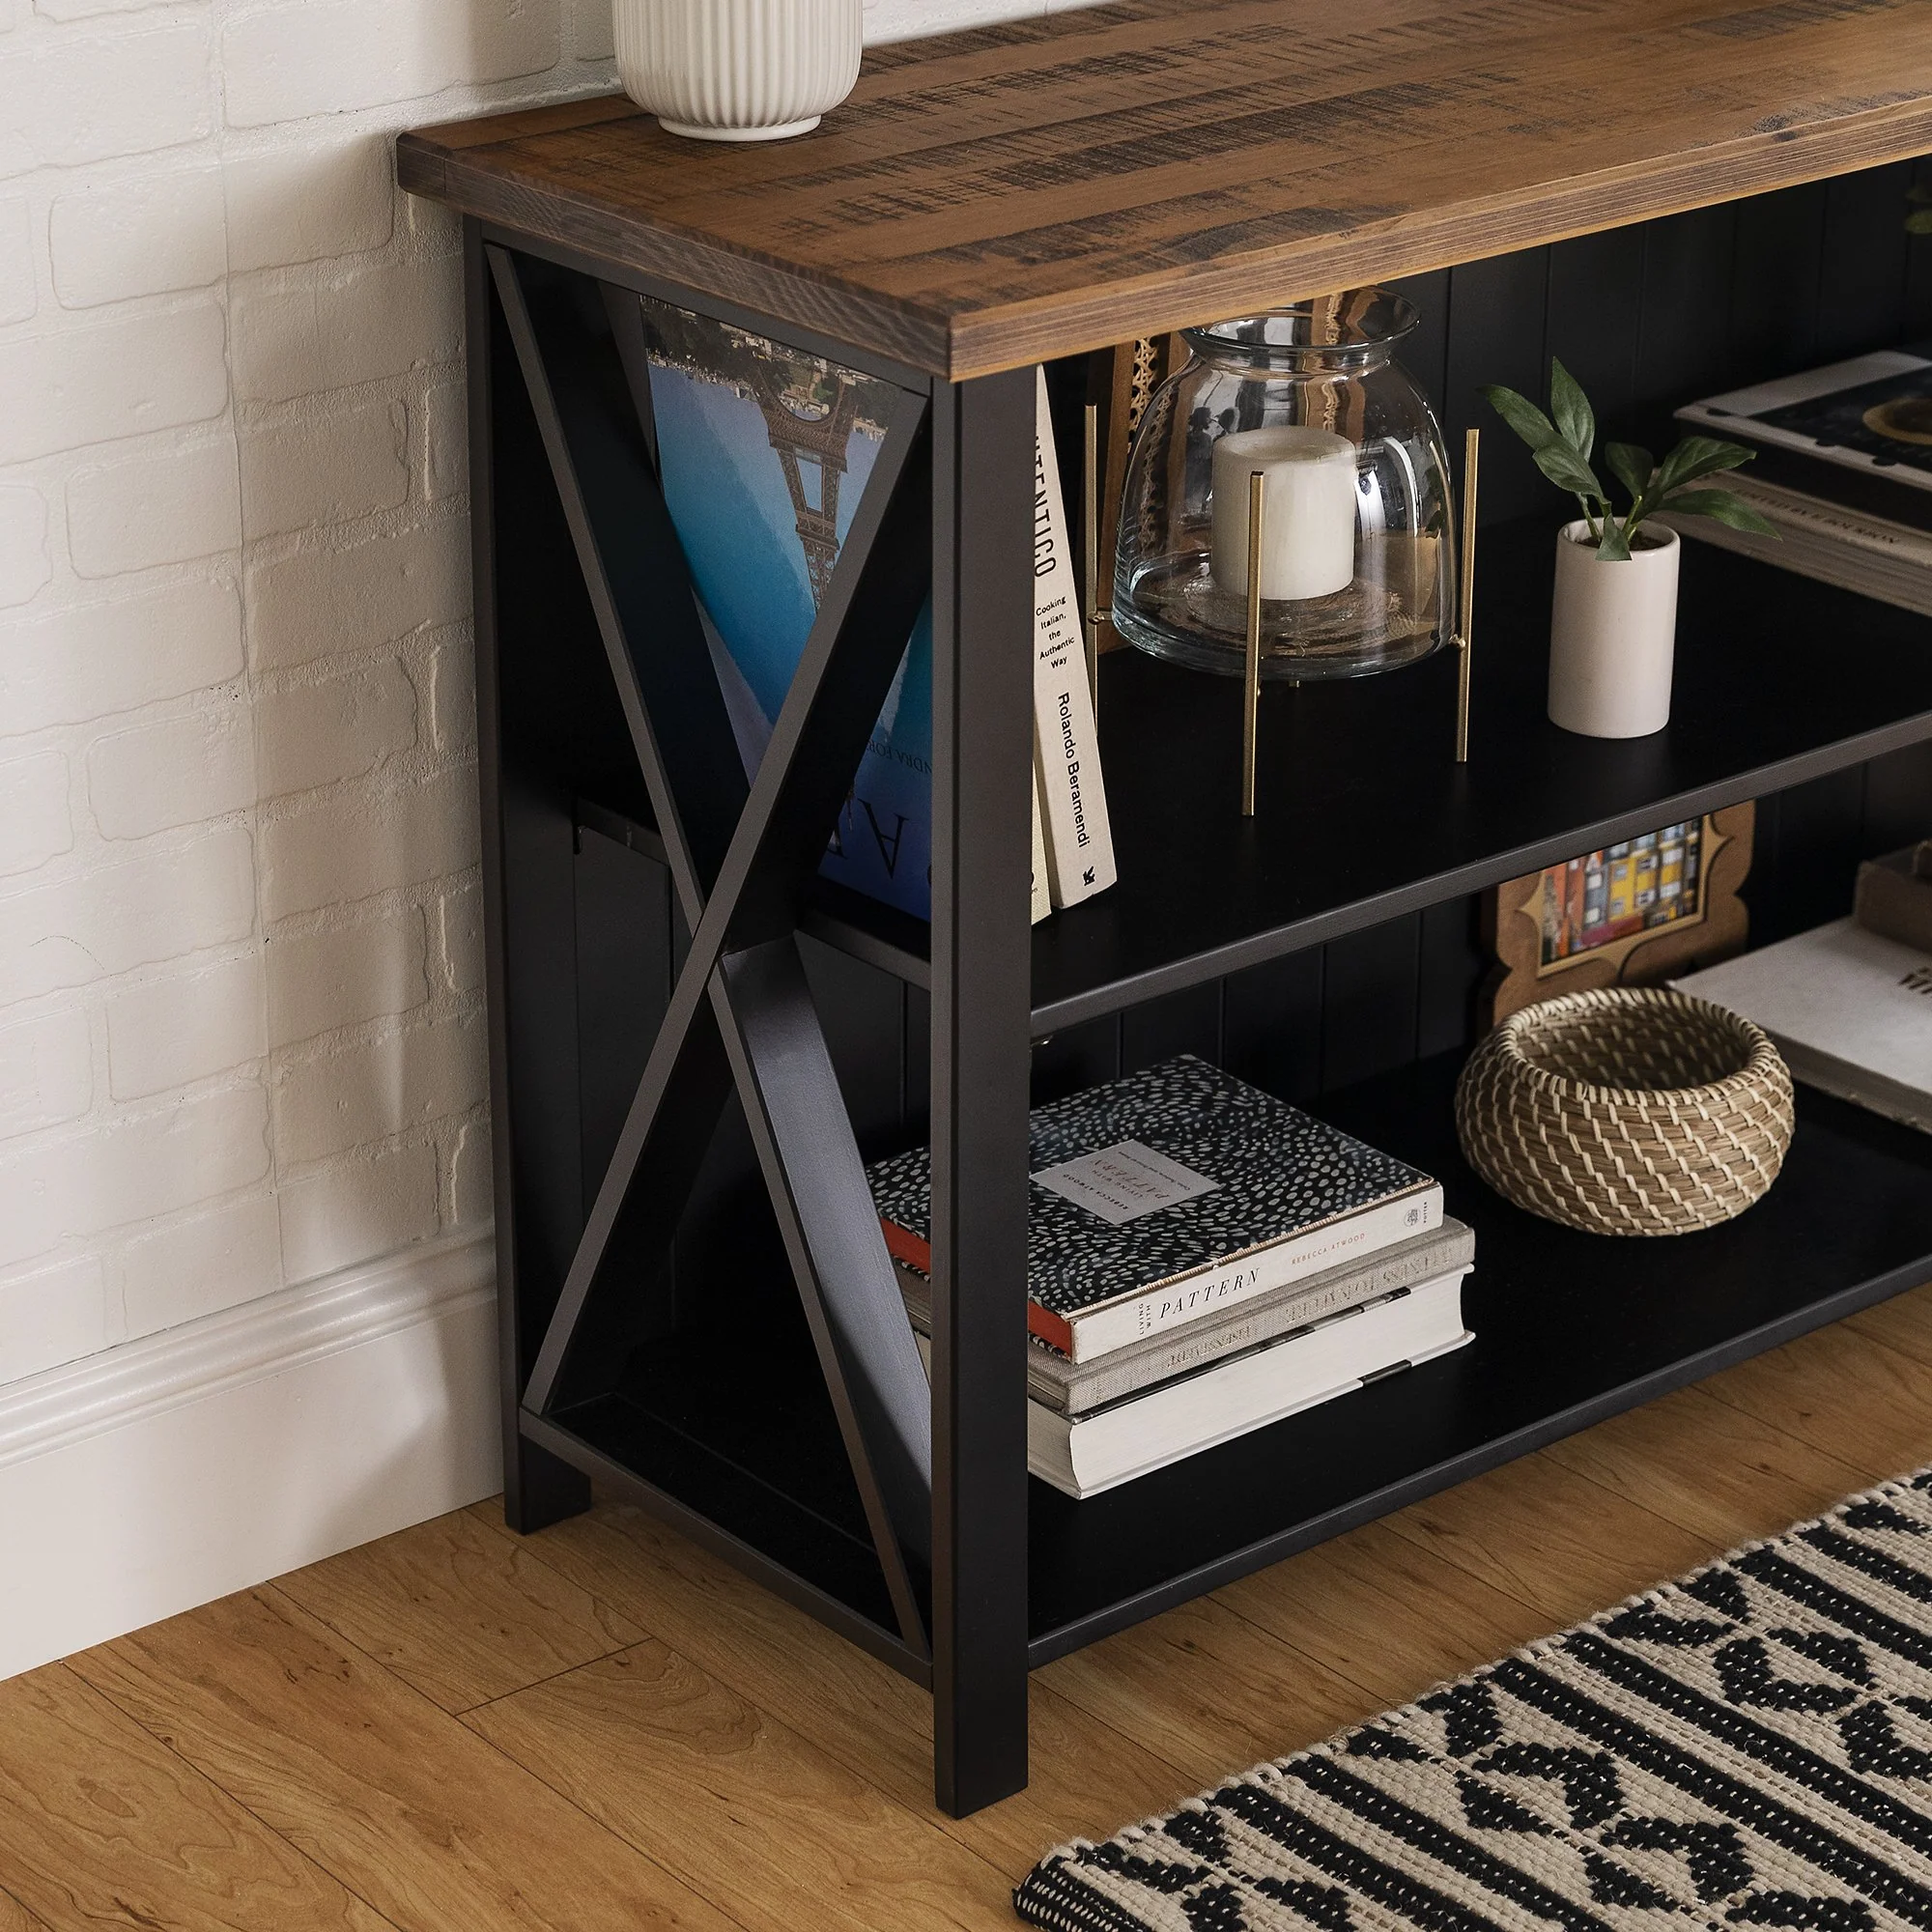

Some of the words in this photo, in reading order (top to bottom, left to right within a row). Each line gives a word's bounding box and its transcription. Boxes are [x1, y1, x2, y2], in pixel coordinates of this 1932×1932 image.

[1036, 596, 1066, 616] Cooking
[1040, 612, 1066, 630] Italian,
[1048, 630, 1062, 640] the
[1039, 637, 1075, 660] Authentic
[1051, 656, 1067, 668] Way
[1058, 692, 1075, 759] Rolando
[1066, 760, 1091, 848] Beramendi
[1292, 1247, 1327, 1264] REBECCA
[1331, 1233, 1365, 1250] ATWOOD
[1159, 1267, 1261, 1319] PATTERN
